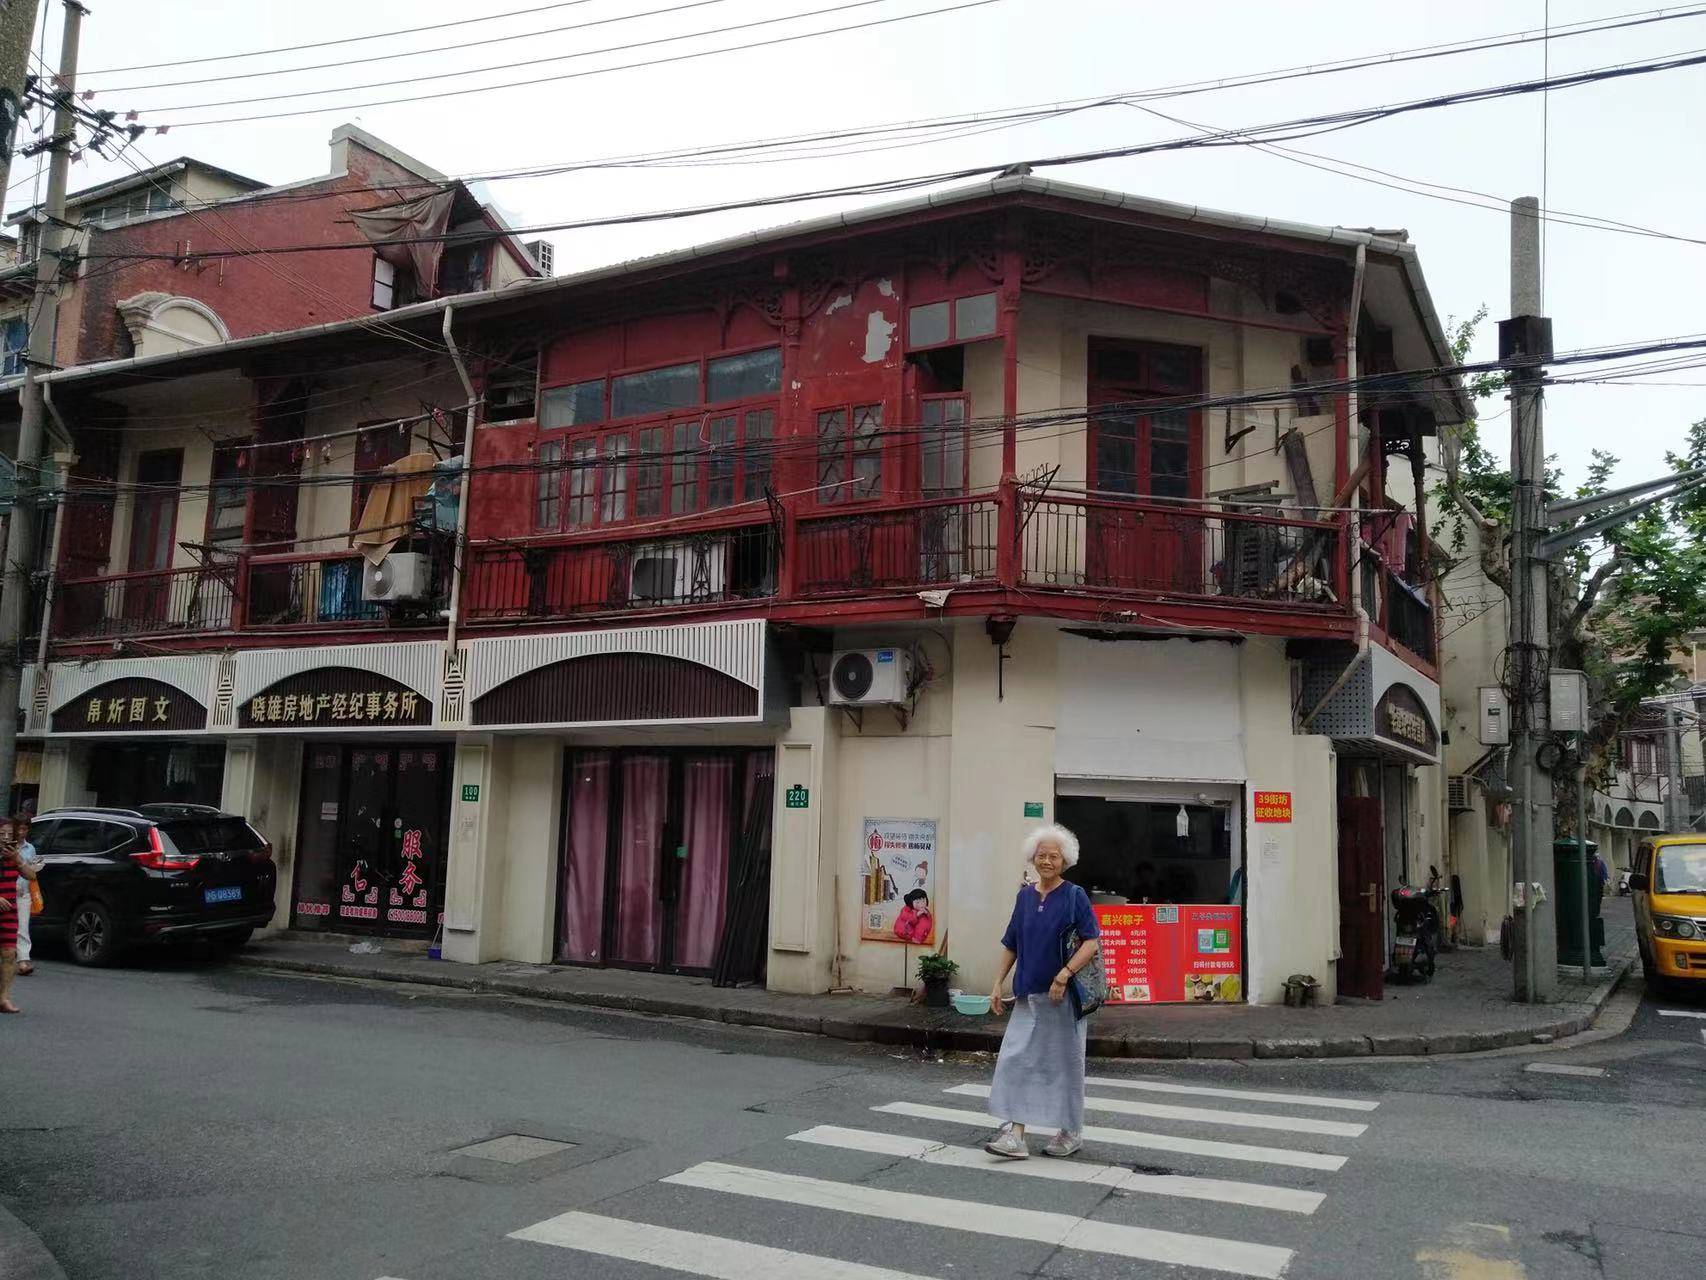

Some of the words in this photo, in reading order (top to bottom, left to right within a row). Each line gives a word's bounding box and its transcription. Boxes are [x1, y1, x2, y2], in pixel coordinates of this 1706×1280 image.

[251, 691, 418, 722] 晓雄房地产经纪事务所
[789, 790, 806, 801] 220
[1258, 794, 1288, 805] 39街坊
[1255, 807, 1291, 818] 征收地块
[399, 829, 422, 895] 服务
[1101, 914, 1144, 926] 嘉兴粽子
